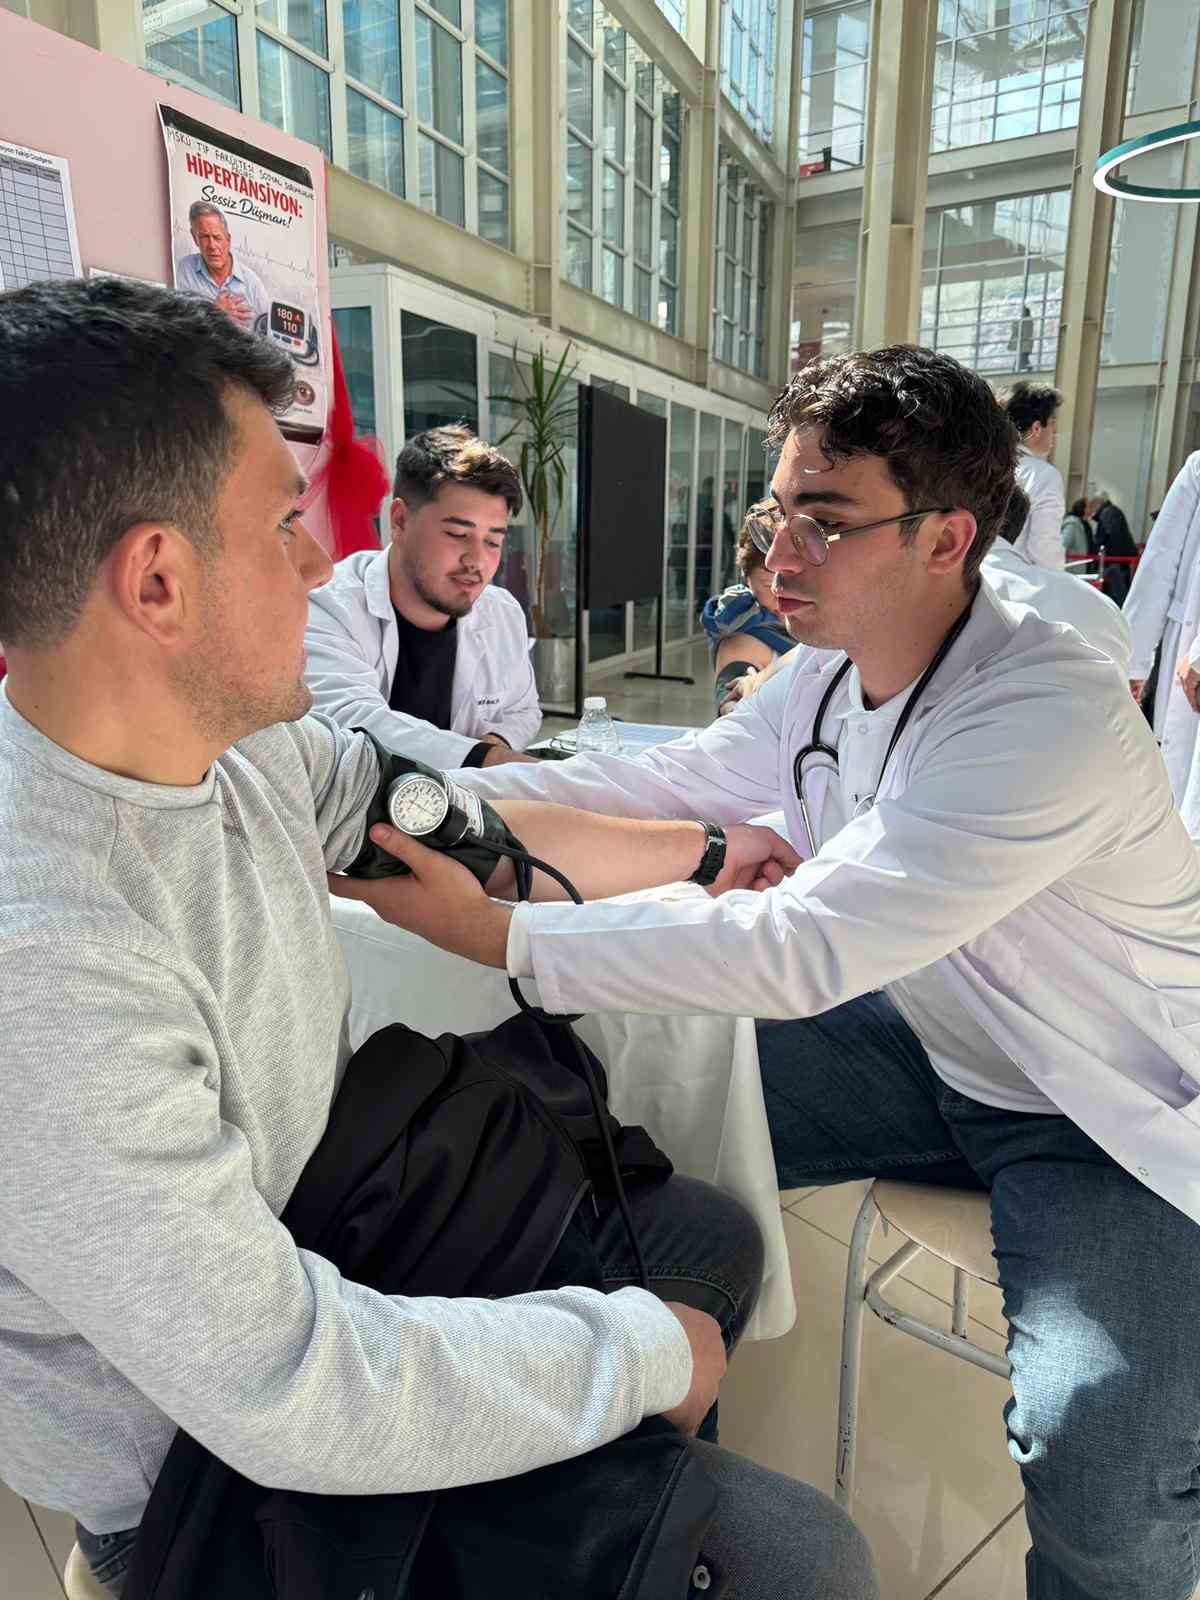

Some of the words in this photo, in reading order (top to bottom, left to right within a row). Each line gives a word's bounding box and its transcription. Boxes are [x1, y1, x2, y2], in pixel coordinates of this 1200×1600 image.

[185, 151, 303, 218] HİPERTANSİYON:
[201, 185, 237, 209] Sessiz
[238, 198, 292, 228] Düşman!
[277, 308, 292, 321] 180
[283, 320, 297, 333] 110
